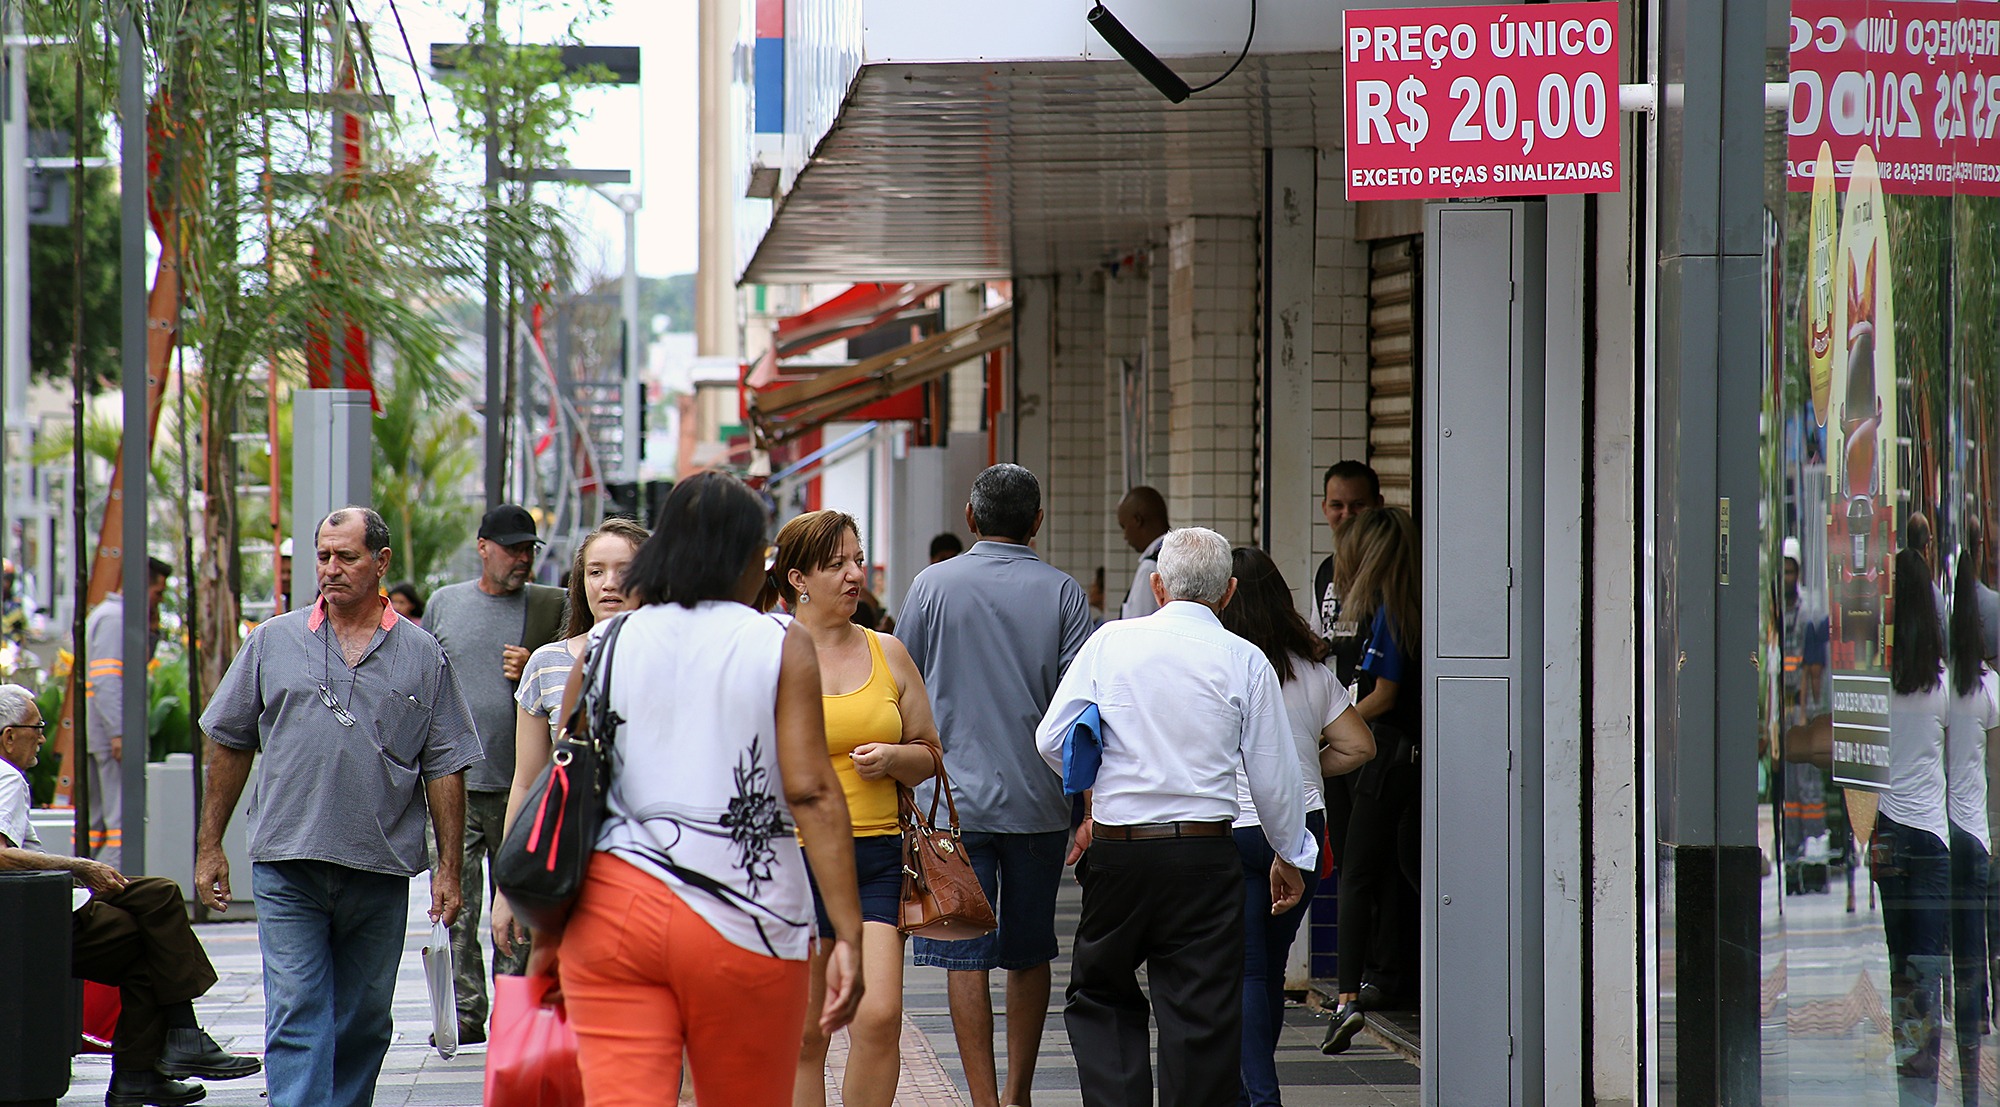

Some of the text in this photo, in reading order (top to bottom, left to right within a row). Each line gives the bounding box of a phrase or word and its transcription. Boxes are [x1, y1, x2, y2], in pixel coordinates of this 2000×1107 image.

[1349, 13, 1613, 70] PREÇO ÚNICO
[1356, 71, 1607, 157] R$ 20,00
[1351, 160, 1615, 188] EXCETO PEÇAS SINALIZADAS
